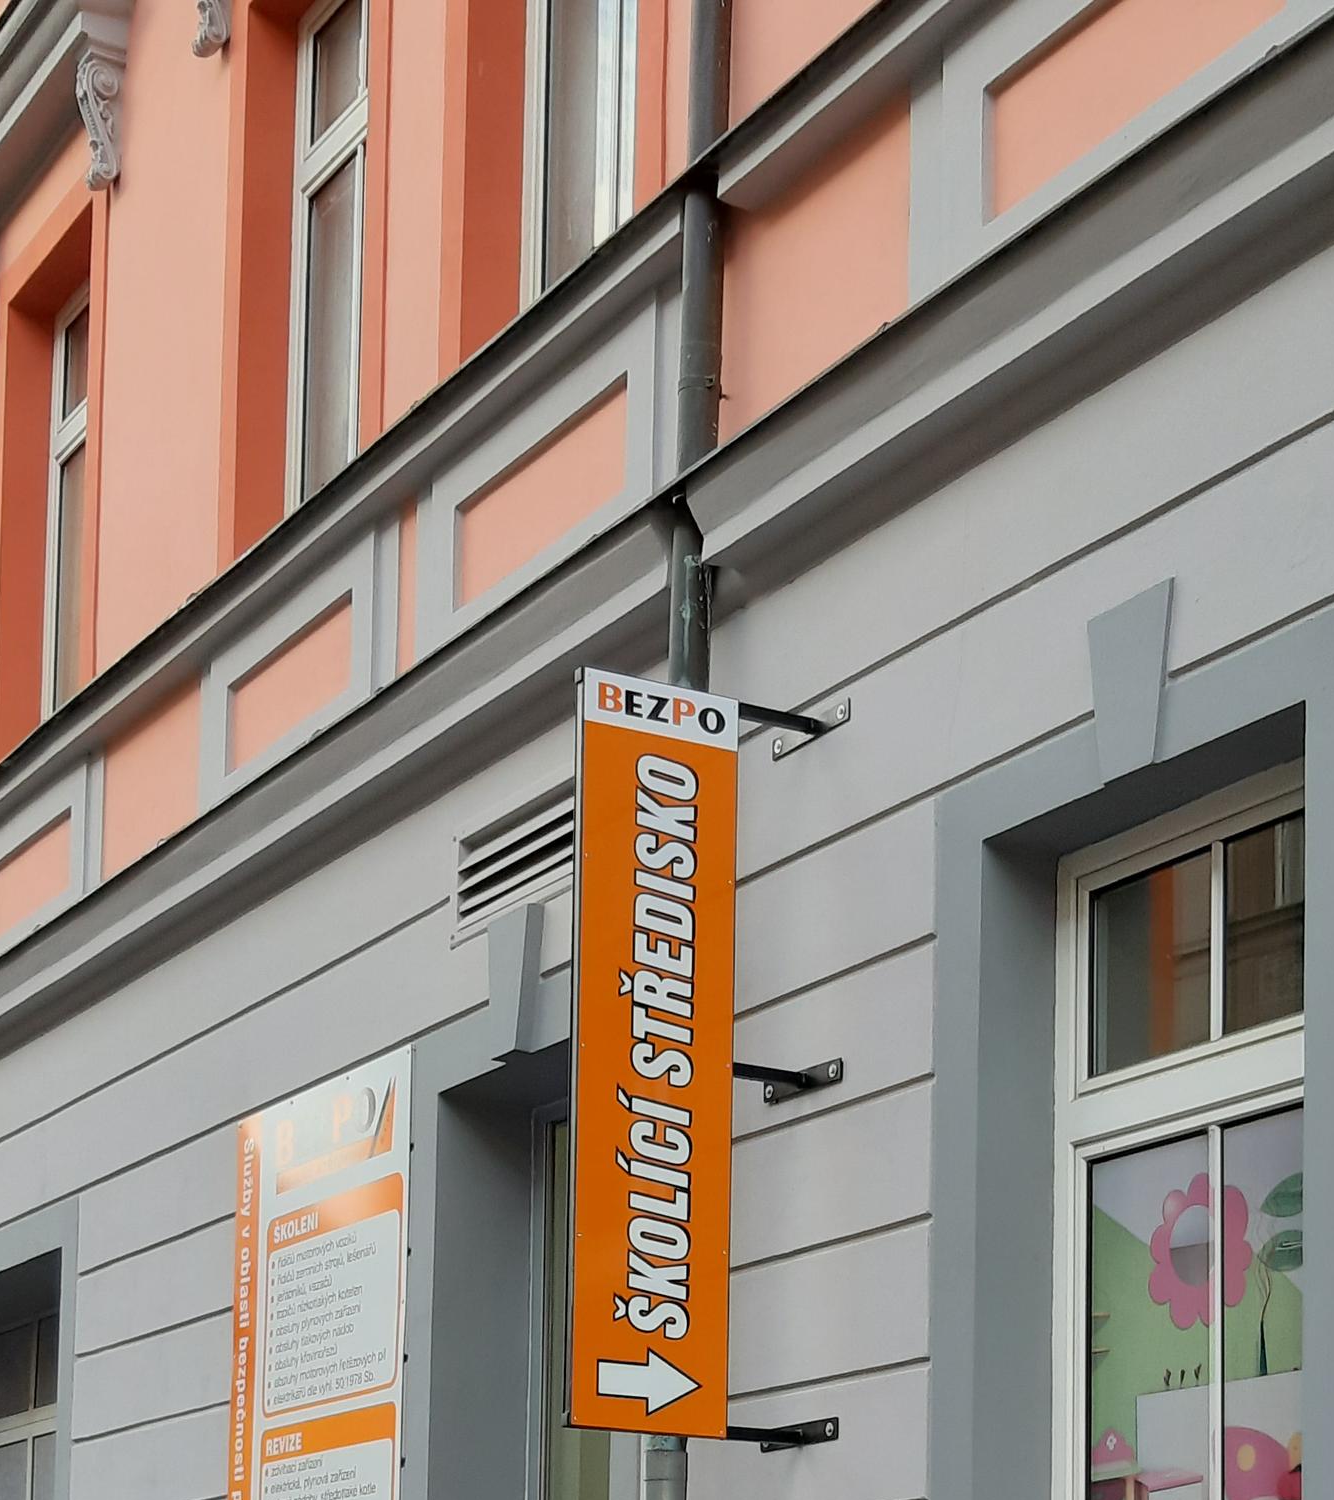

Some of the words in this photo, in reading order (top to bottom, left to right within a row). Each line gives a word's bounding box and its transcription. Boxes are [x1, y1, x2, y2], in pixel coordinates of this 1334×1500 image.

[598, 681, 726, 735] BEZPO
[619, 752, 700, 1089] STŘEDISKO
[240, 1137, 255, 1216] Služby
[613, 1085, 693, 1340] ŠKOLÍCÍ
[242, 1225, 251, 1238] v
[238, 1247, 252, 1328] oblasti
[233, 1336, 250, 1481] bezpečnosti
[266, 1432, 302, 1456] REVIZE
